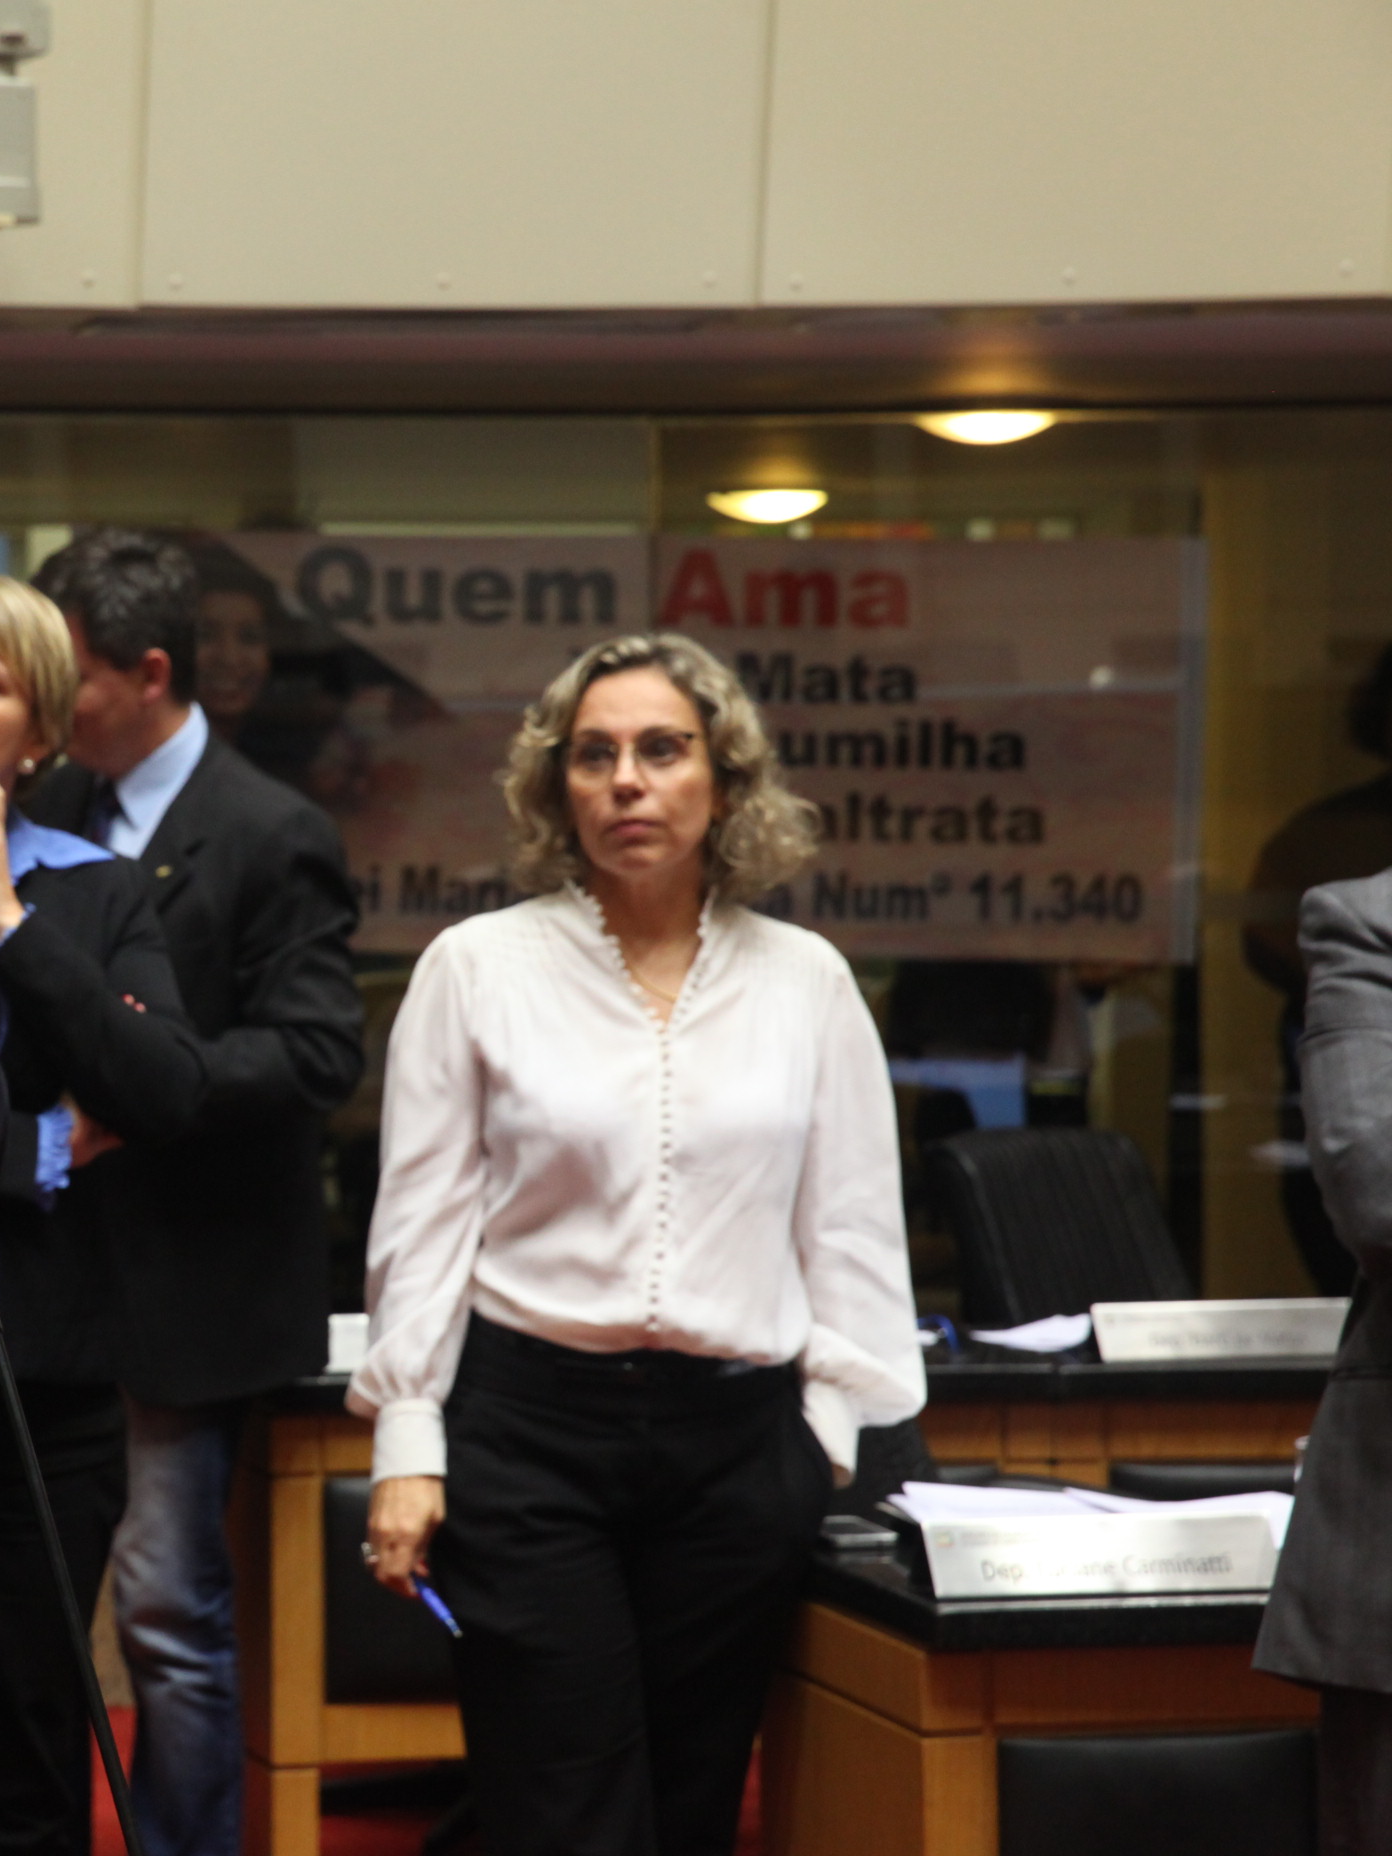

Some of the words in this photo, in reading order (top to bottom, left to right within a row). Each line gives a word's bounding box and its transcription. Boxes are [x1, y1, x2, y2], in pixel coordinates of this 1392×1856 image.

[299, 546, 617, 627] Quem
[659, 549, 911, 629] Ama
[736, 651, 917, 705] Mata
[779, 719, 1026, 769] umilha
[819, 793, 1045, 845] altrata
[400, 865, 523, 914] Mari
[969, 873, 1143, 922] 11.340
